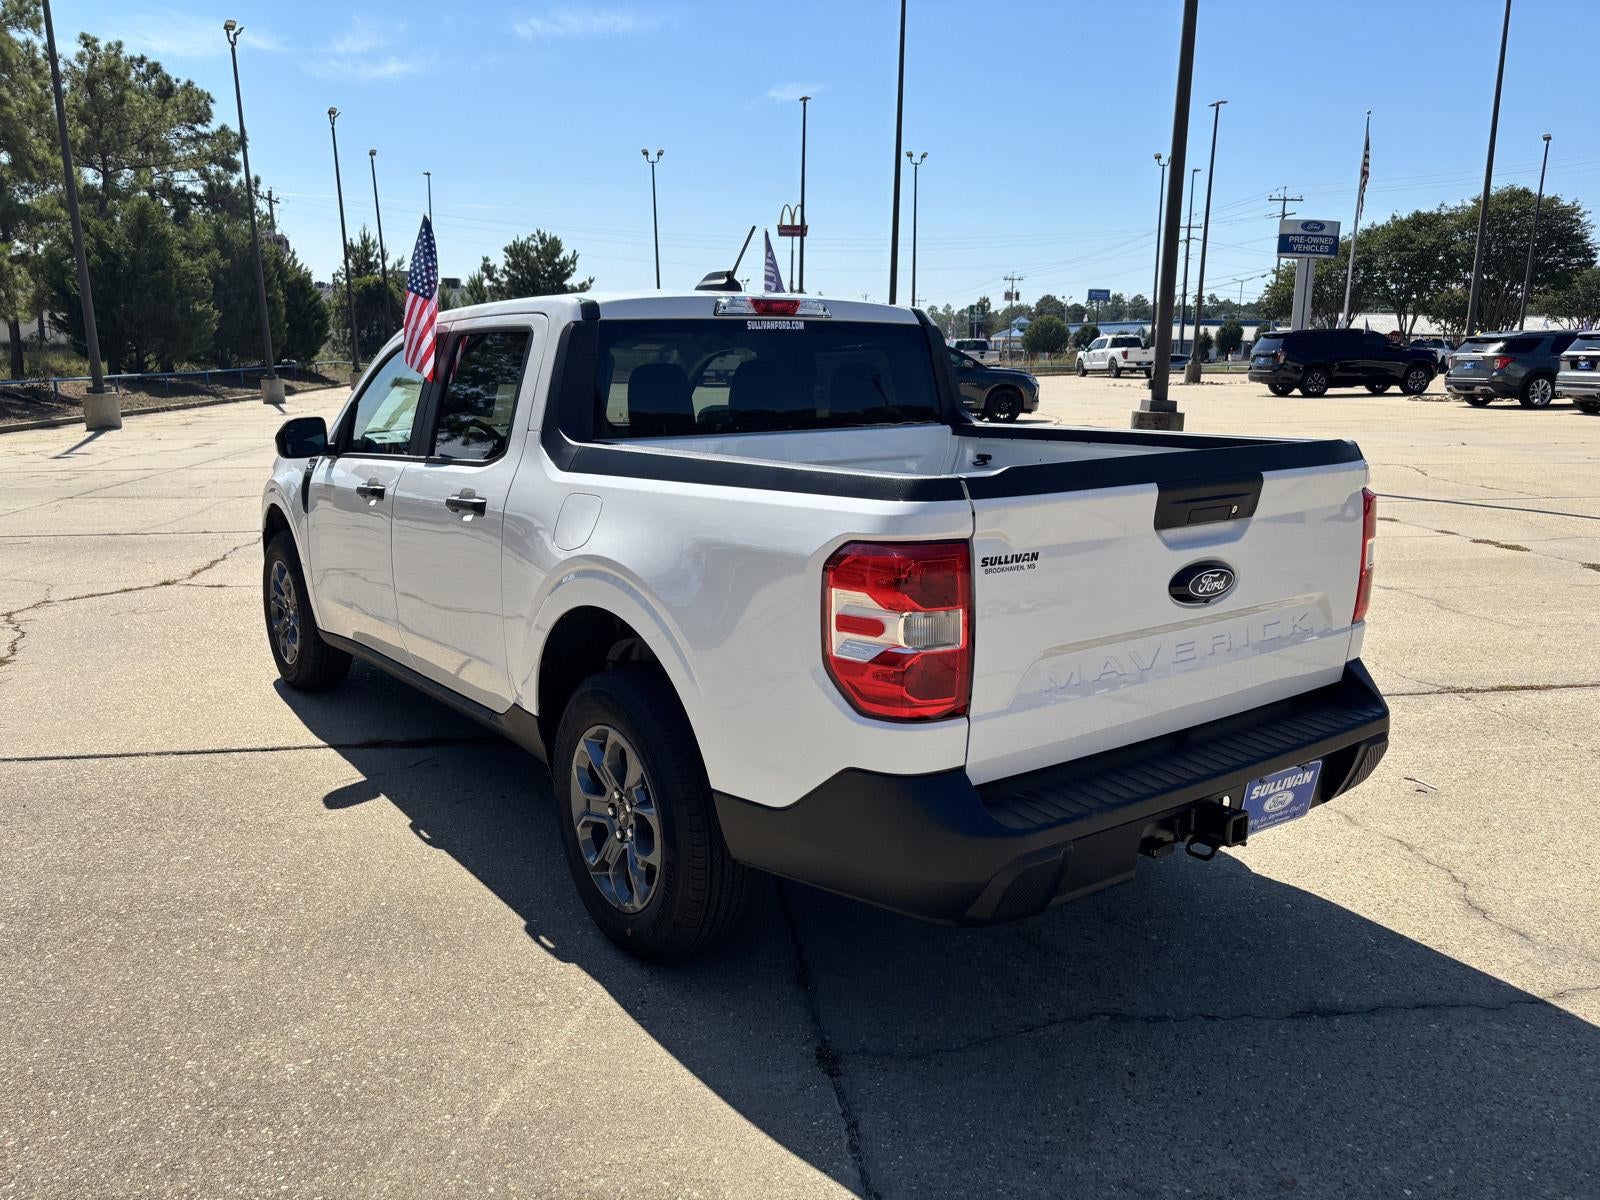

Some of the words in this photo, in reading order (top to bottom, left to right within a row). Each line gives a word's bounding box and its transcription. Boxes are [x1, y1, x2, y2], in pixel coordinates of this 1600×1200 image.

[1288, 235, 1334, 245] PRE-OWNED
[1292, 243, 1330, 252] VEHICLES
[746, 320, 805, 330] SULLIVANFORD.COM
[980, 551, 1039, 567] SULLIVAN
[984, 565, 1026, 575] BROOKHAVEN,
[1198, 572, 1227, 593] Ford
[1043, 611, 1314, 693] MAVERICK
[1249, 770, 1315, 800] SULLIVAN
[1268, 794, 1289, 810] Ford
